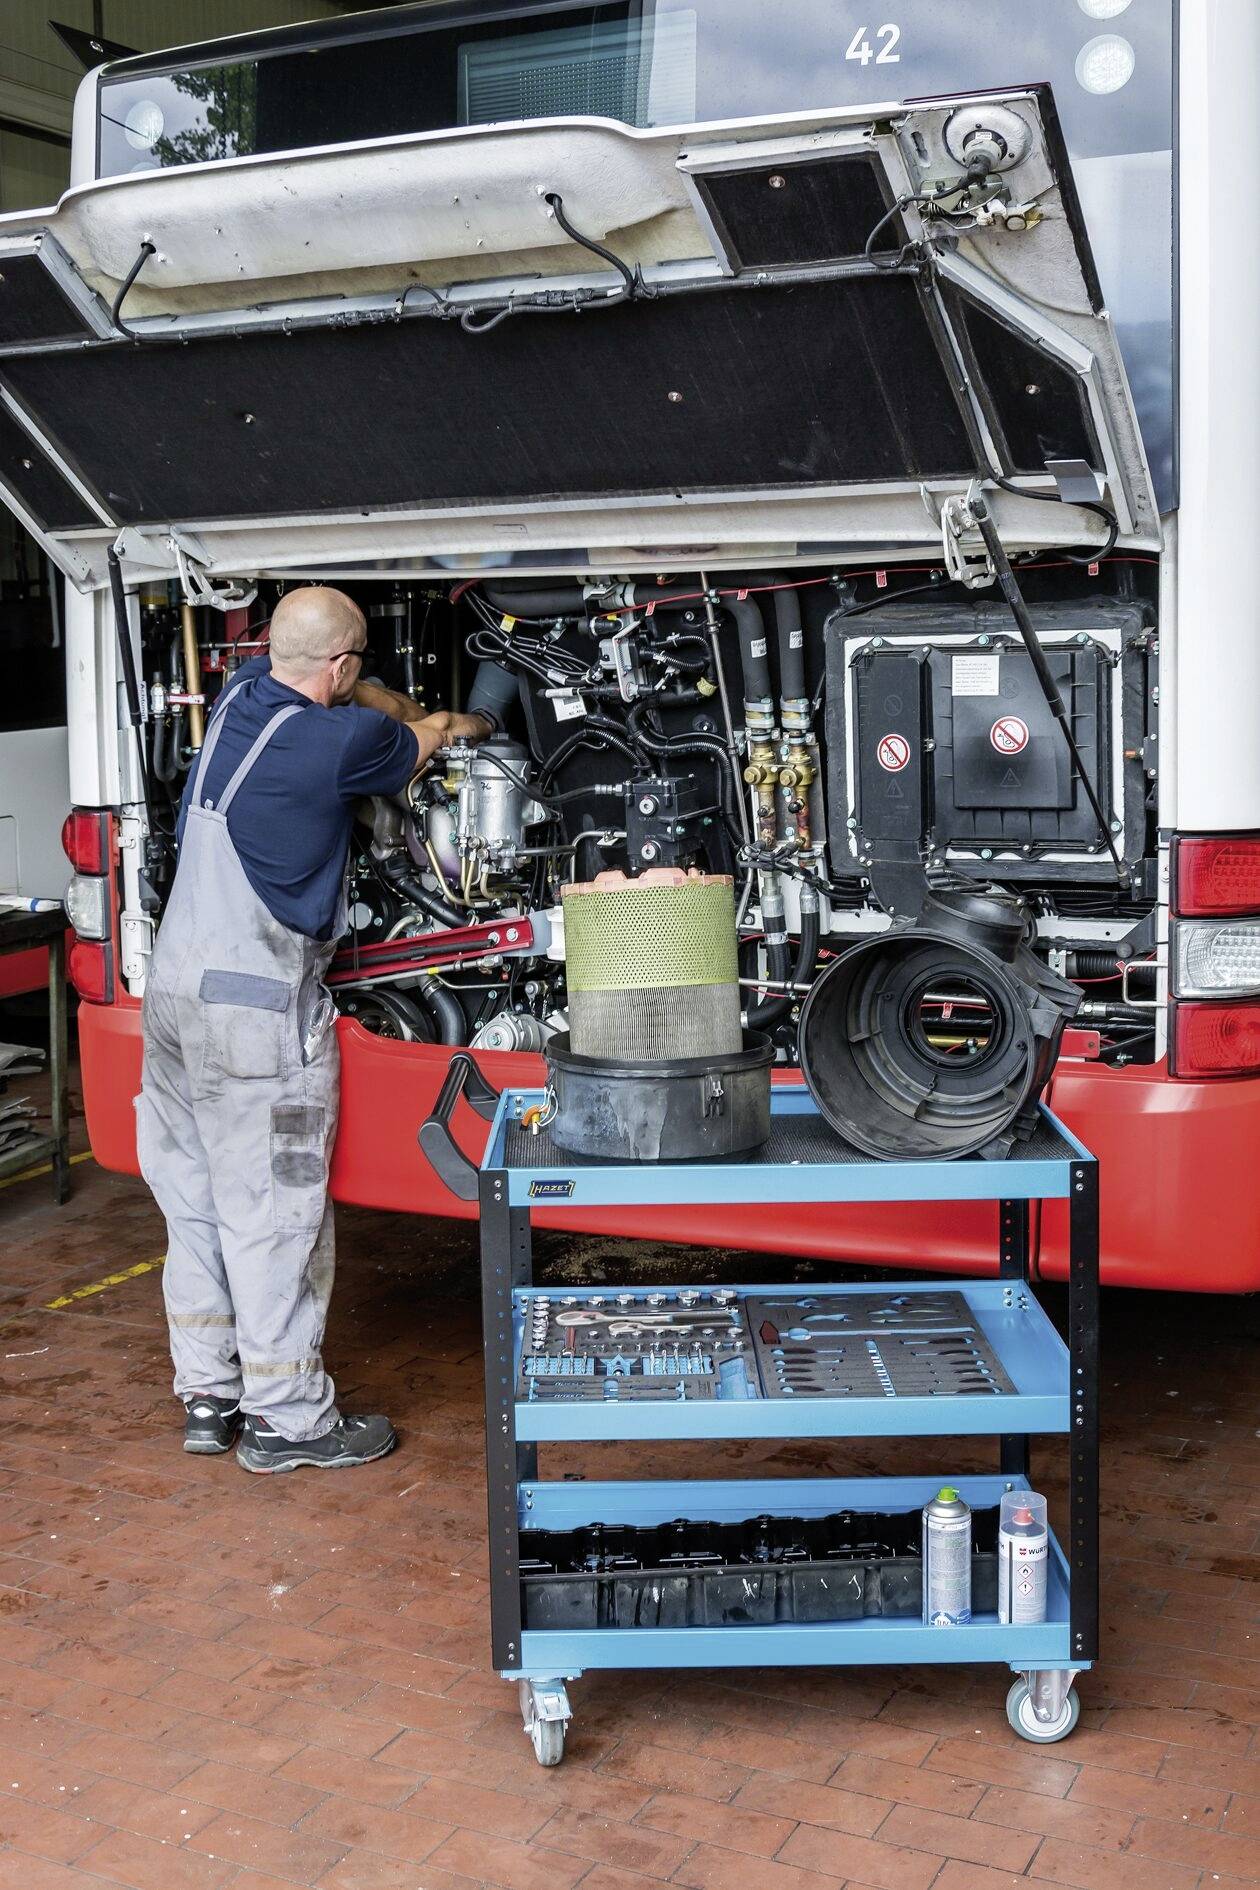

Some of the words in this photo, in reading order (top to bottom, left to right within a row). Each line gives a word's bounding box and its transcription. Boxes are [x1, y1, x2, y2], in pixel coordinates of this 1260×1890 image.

[845, 23, 900, 66] 42
[533, 1184, 570, 1194] HAZET
[1028, 1545, 1047, 1555] WÜRT
